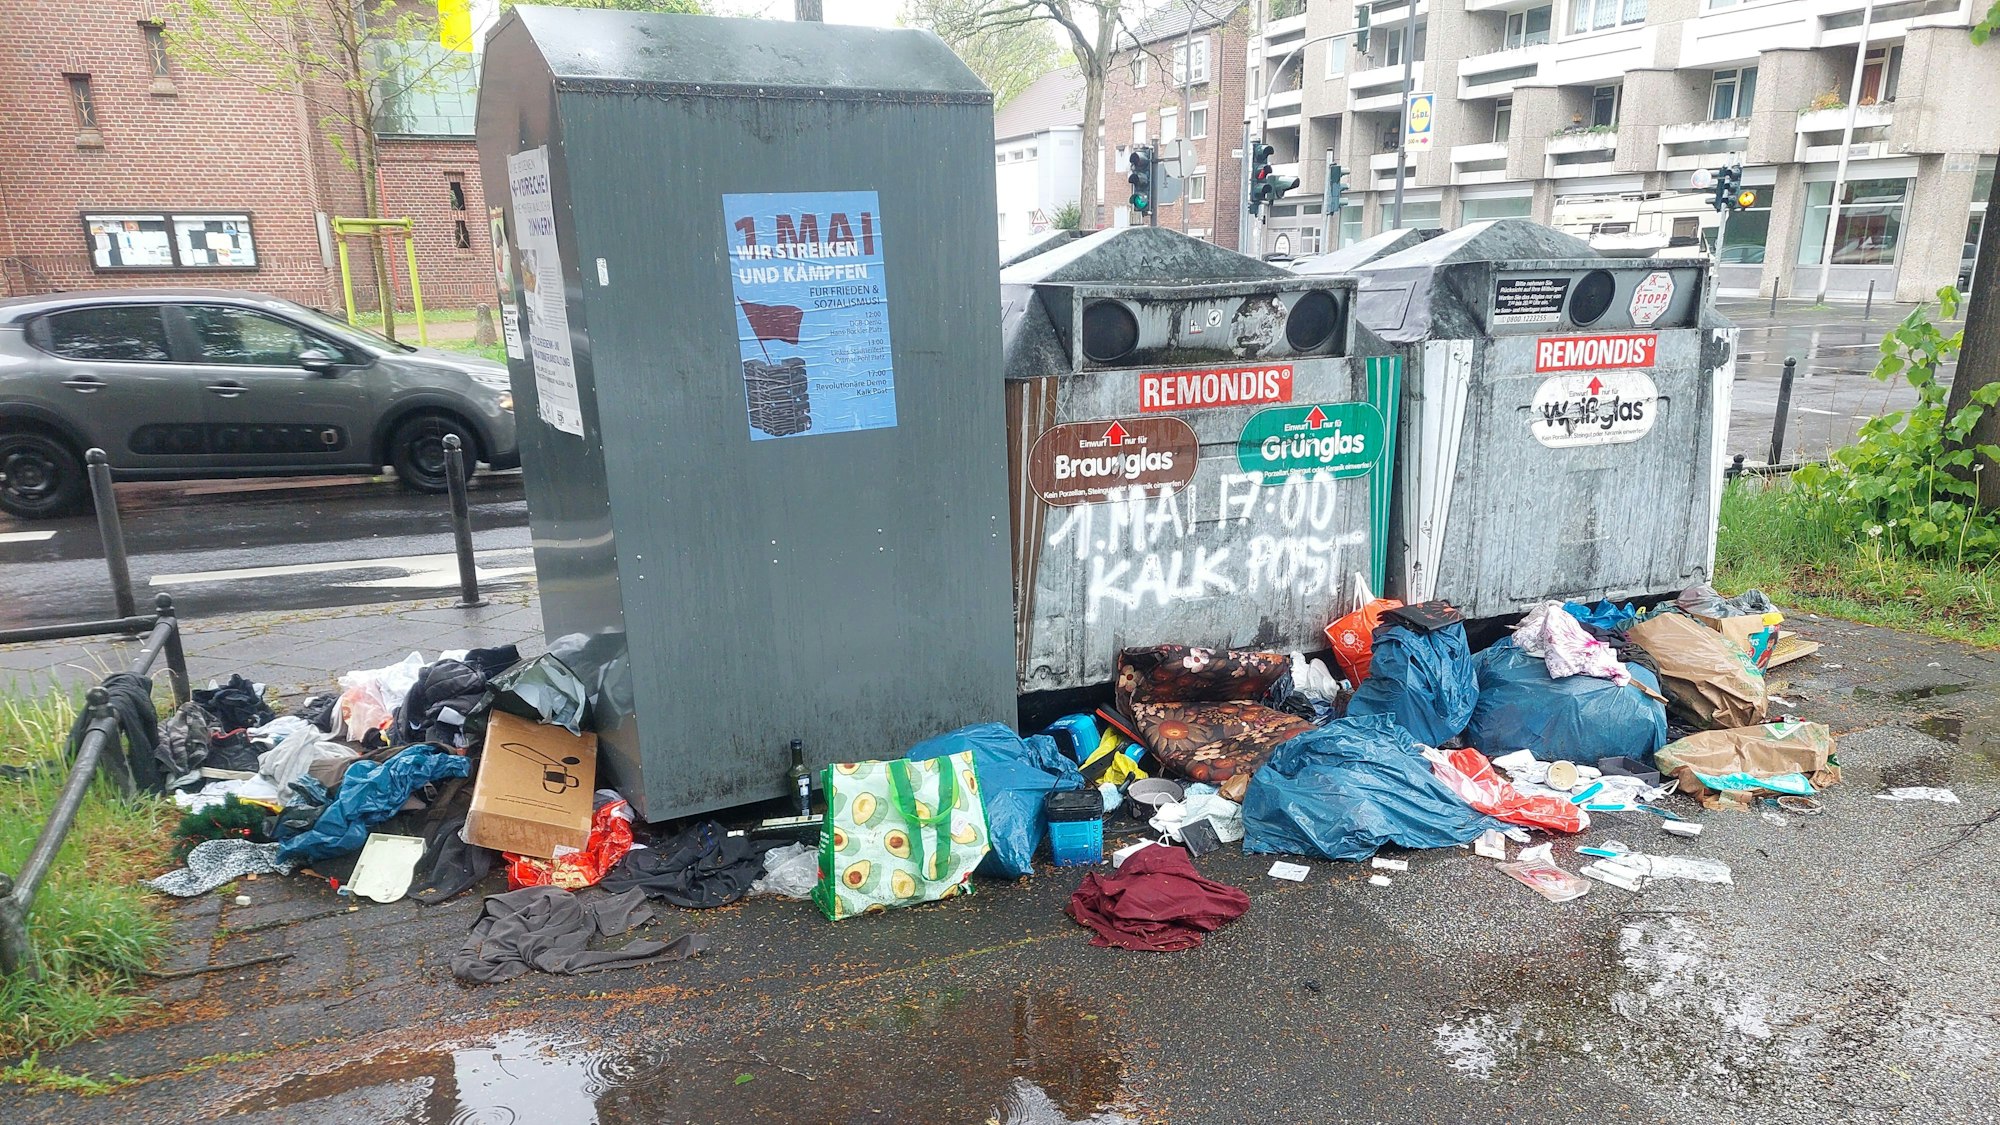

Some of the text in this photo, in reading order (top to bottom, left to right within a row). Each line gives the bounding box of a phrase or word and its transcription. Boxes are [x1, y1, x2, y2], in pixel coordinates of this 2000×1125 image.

[735, 212, 875, 259] 1 MAI
[736, 240, 859, 260] WIR STREIKEN
[739, 262, 868, 285] UND KÄMPFEN
[831, 285, 870, 296] FRIEDEN
[872, 284, 879, 294] &
[1636, 293, 1668, 304] STOPP
[857, 388, 872, 396] Kalk
[1569, 390, 1589, 398] Einwurf
[1284, 423, 1308, 432] Einwurf
[1334, 419, 1342, 427] für
[1080, 436, 1148, 448] Einwurf nur für
[1261, 429, 1365, 463] Grünglas
[1043, 491, 1058, 499] Kein
[1059, 488, 1087, 498] Porzellan,
[1218, 472, 1337, 531] 17:00
[1086, 530, 1366, 623] KALK POST
